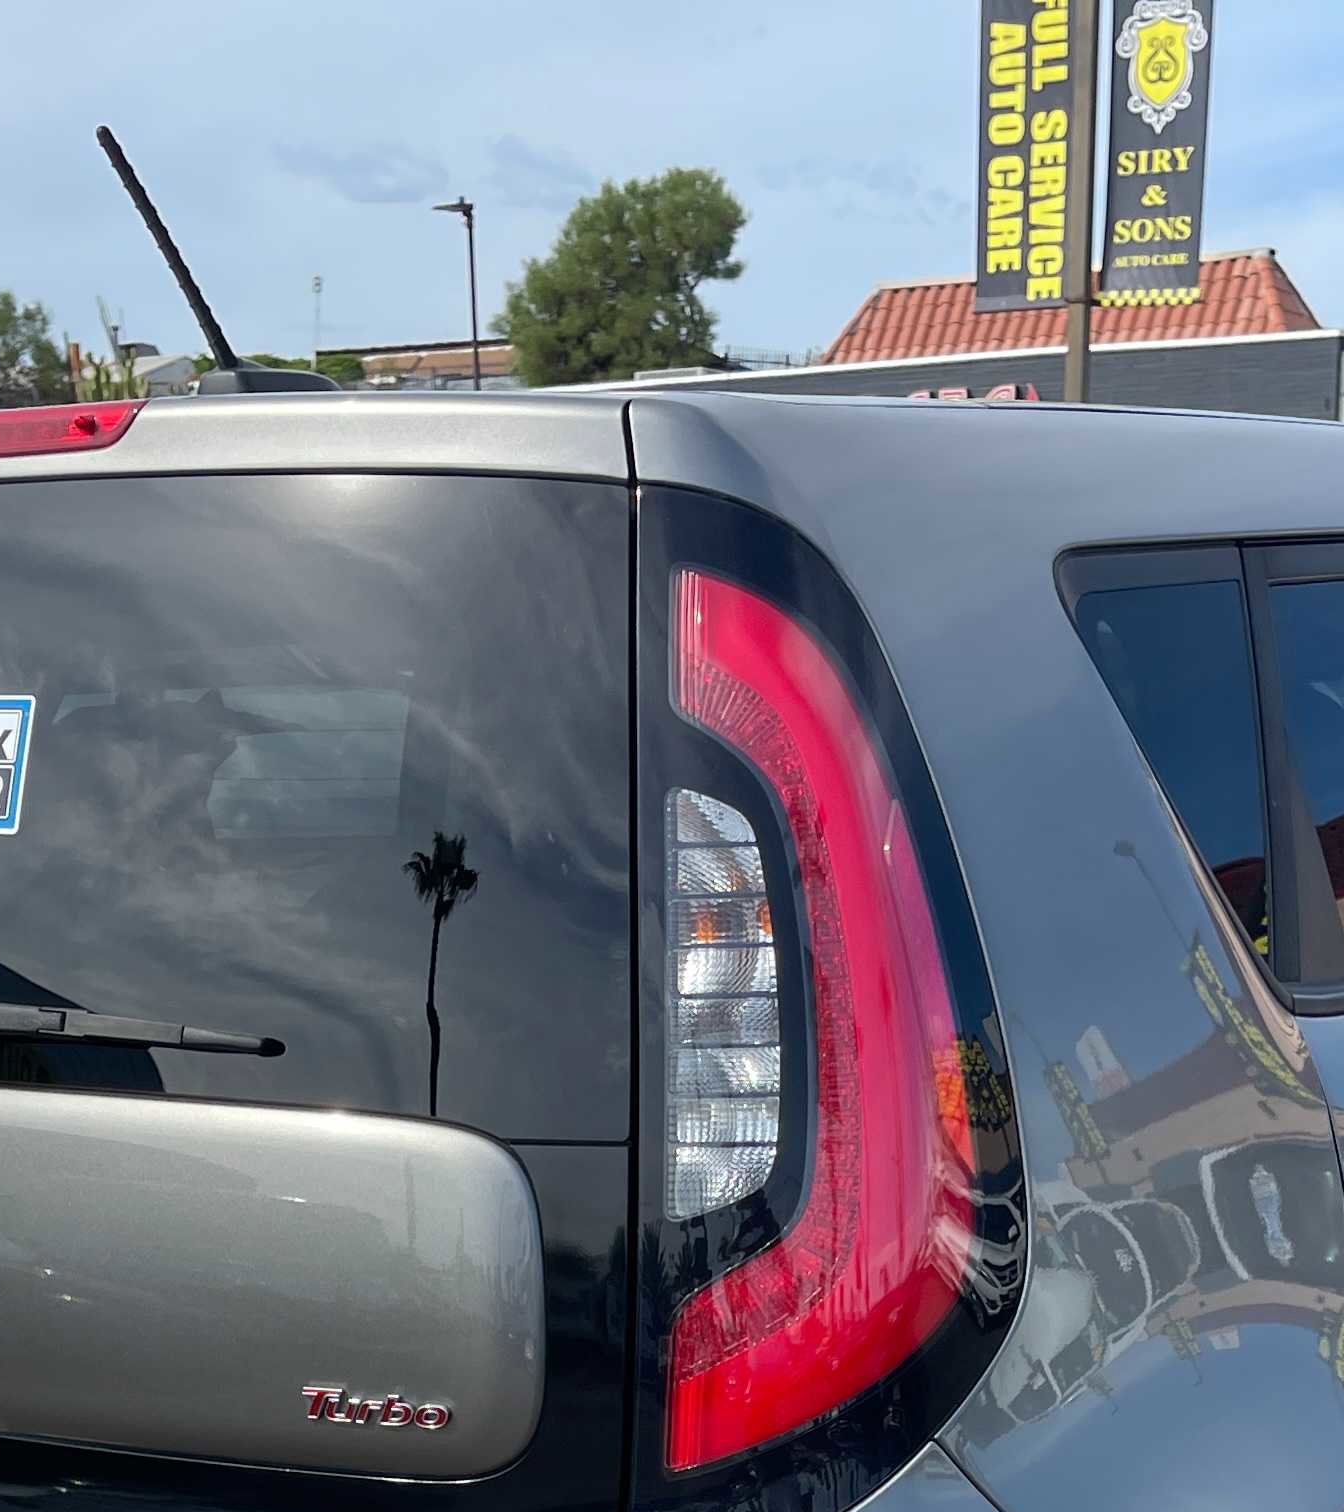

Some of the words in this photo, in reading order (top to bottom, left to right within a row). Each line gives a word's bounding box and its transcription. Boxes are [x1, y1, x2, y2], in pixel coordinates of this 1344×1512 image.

[988, 22, 1026, 145] AUTO
[1116, 146, 1195, 176] SIRY
[986, 155, 1024, 273] CARE
[1027, 109, 1068, 301] SERVICE
[1140, 184, 1168, 207] &
[1112, 216, 1192, 244] SONS
[301, 1386, 449, 1430] Turbo
